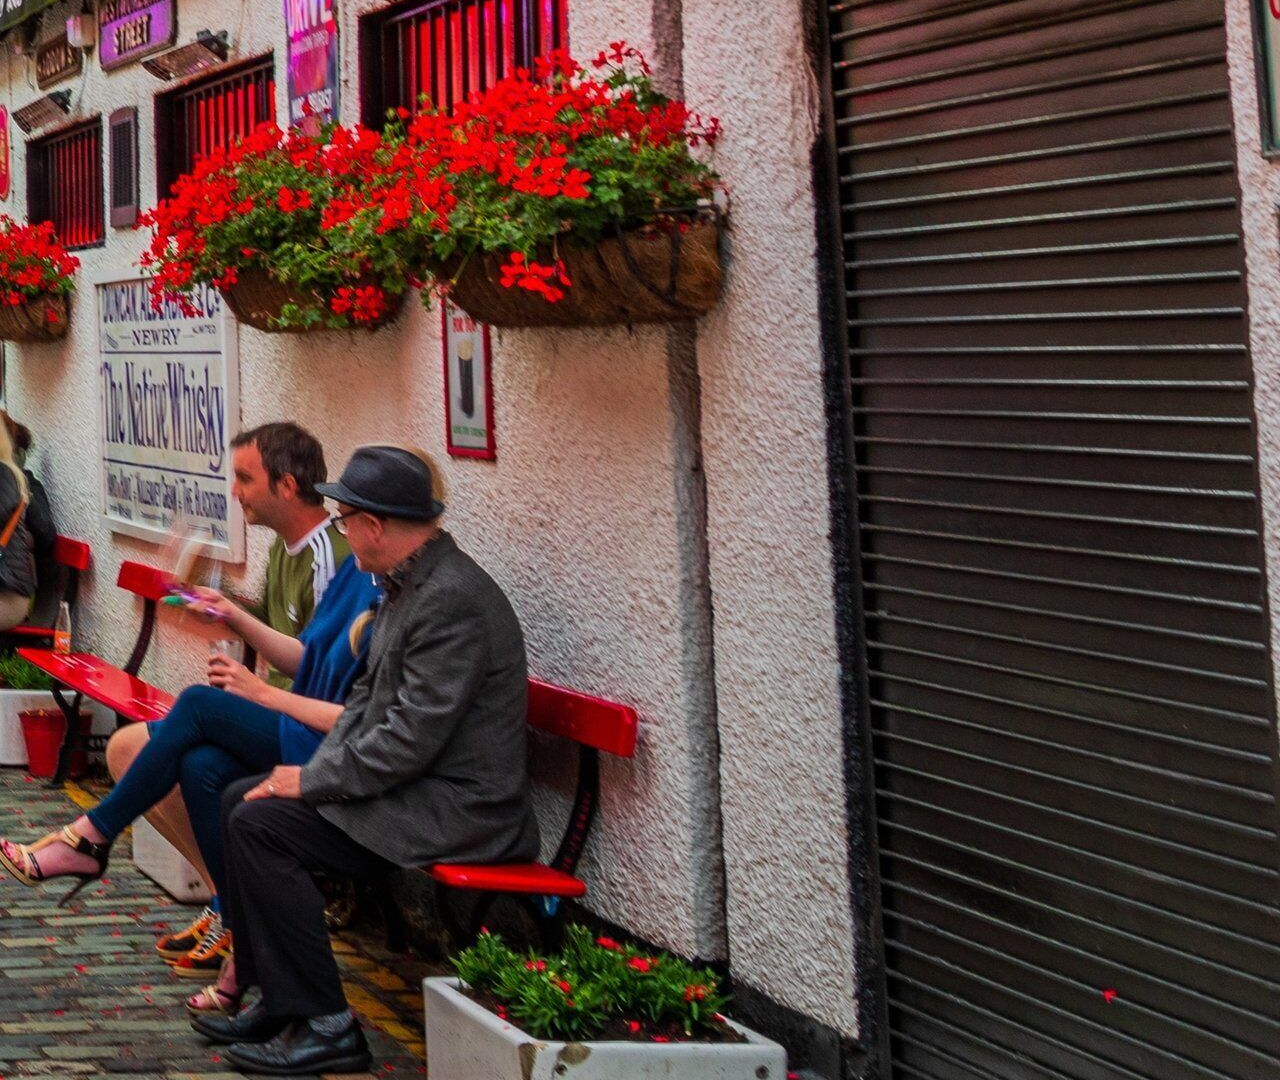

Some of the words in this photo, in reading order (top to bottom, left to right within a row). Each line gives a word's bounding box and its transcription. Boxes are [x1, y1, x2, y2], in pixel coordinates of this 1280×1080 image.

[132, 328, 180, 346] NEWRY
[103, 361, 124, 444] The
[125, 361, 168, 449] Native
[167, 362, 224, 472] Whisky
